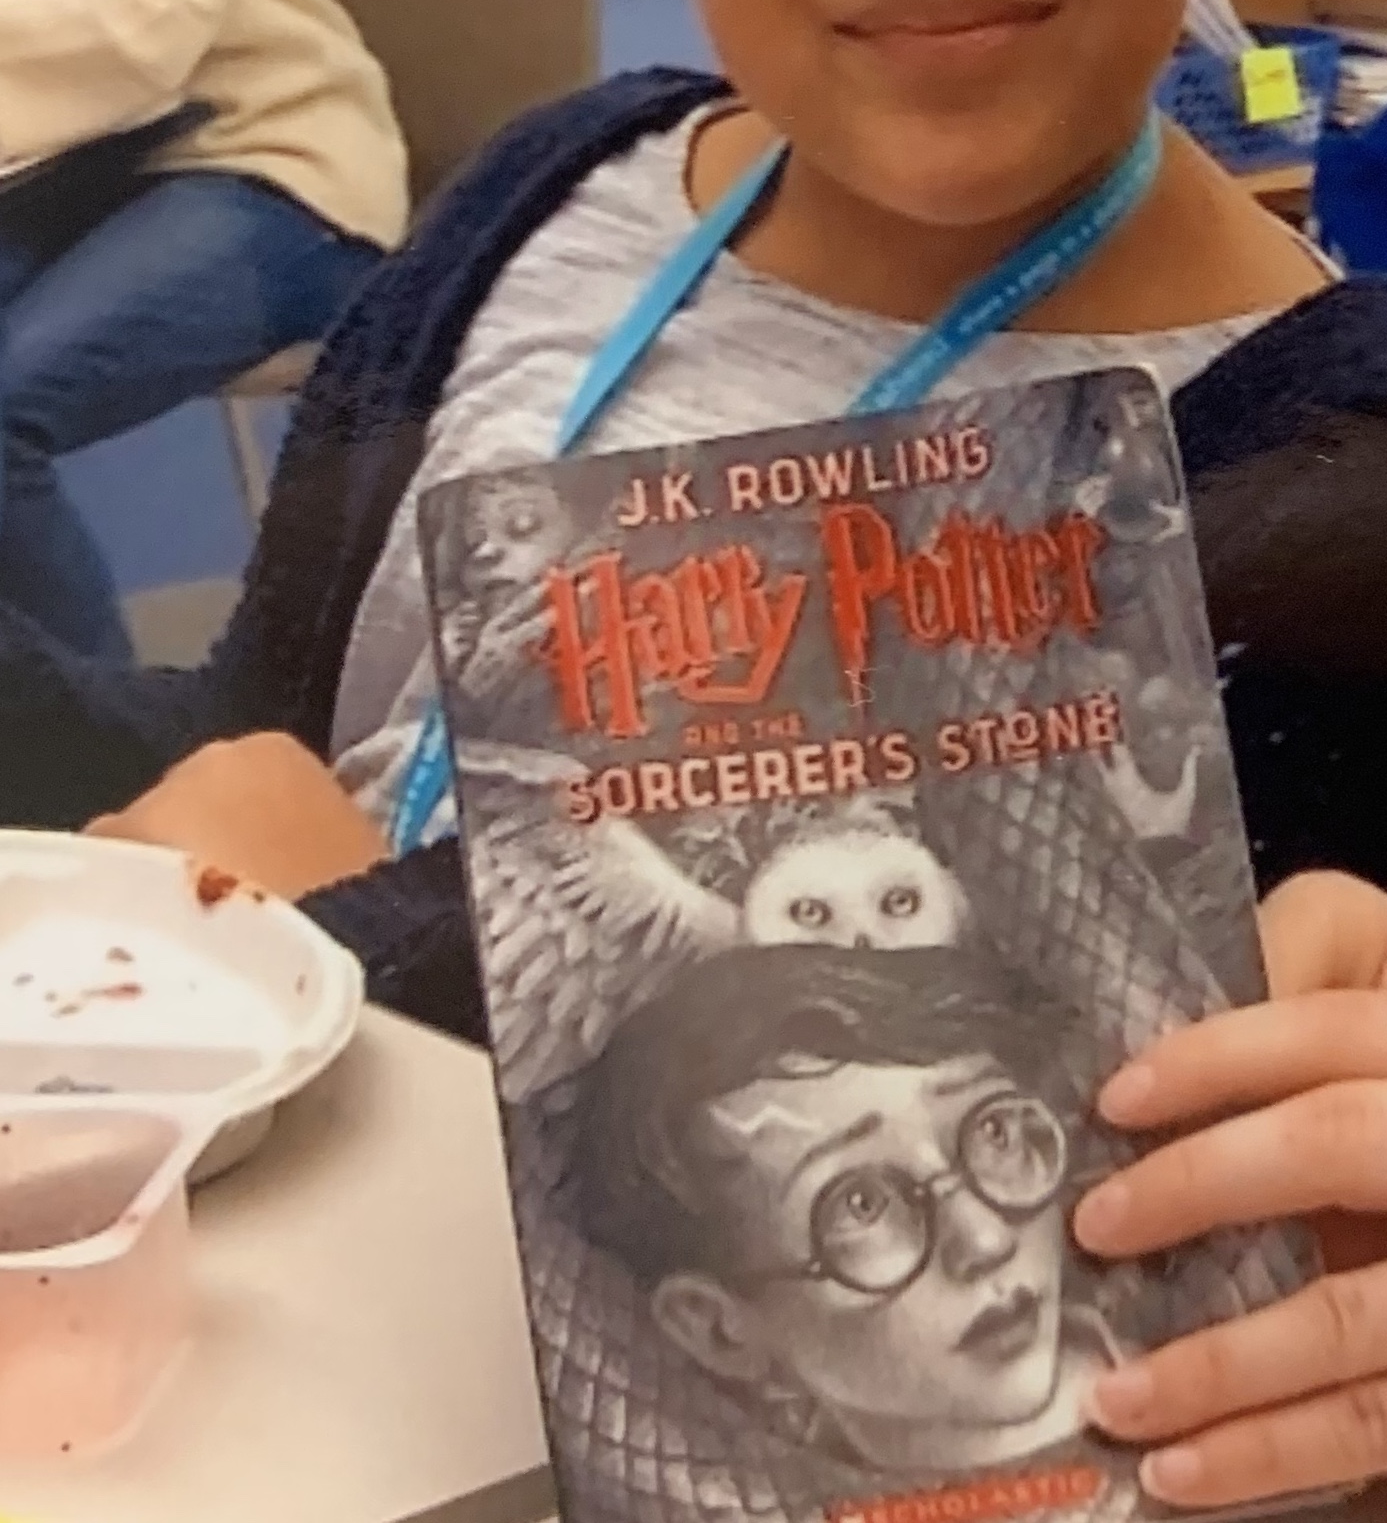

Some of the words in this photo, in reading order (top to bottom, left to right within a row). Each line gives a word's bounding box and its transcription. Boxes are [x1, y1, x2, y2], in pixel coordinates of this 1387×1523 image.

[616, 471, 713, 528] J.K.
[725, 427, 991, 513] ROWLING
[540, 547, 806, 740] Harry
[818, 501, 1105, 722] Potter
[566, 729, 918, 824] SORCERER'S
[935, 692, 1122, 773] STONE
